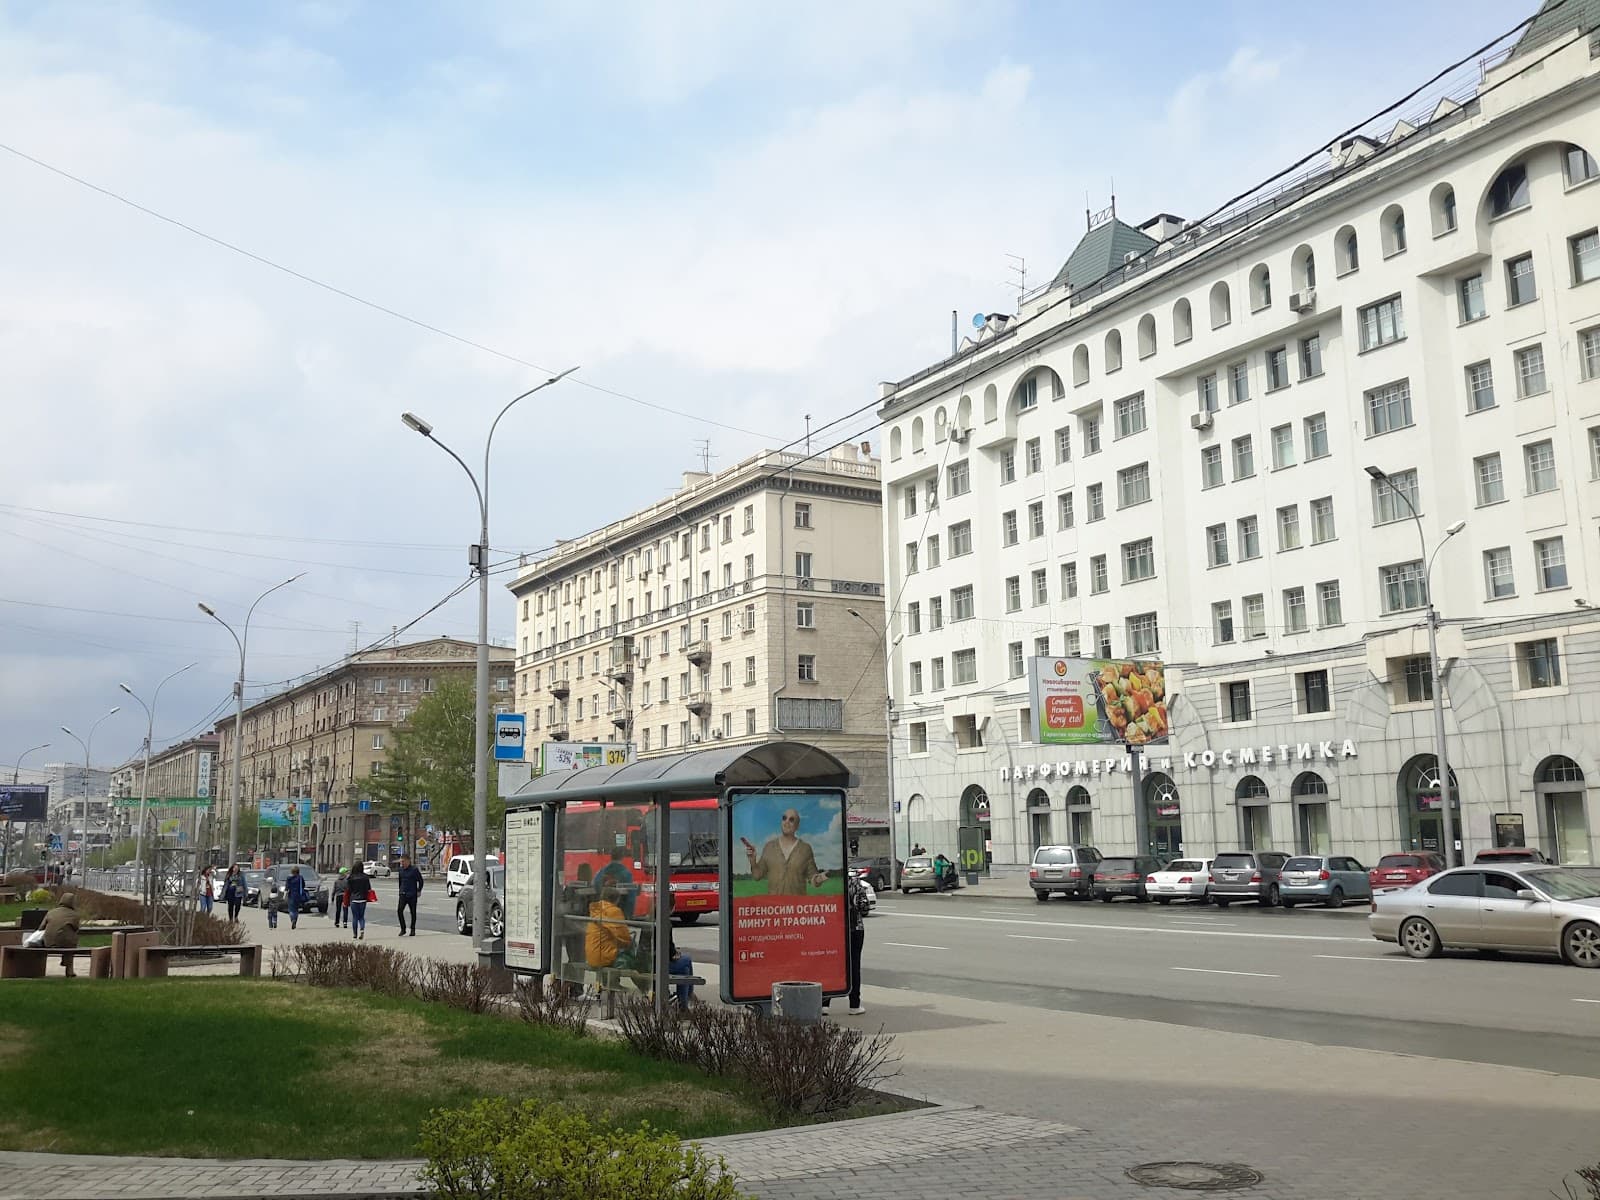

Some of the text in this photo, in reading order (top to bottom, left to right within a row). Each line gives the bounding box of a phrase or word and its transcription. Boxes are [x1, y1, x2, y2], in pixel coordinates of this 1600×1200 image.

[1049, 714, 1066, 727] Хочу
[608, 749, 626, 764] 379
[999, 756, 1149, 781] ПАРФЮМЕРИЯ
[1183, 738, 1358, 768] КОСМЕТИКА
[738, 903, 837, 916] ПЕРЕНОСИМ ОСТАТКИ
[738, 916, 826, 928] МИНУТ И ТРАФИКА
[749, 951, 764, 959] МТС
